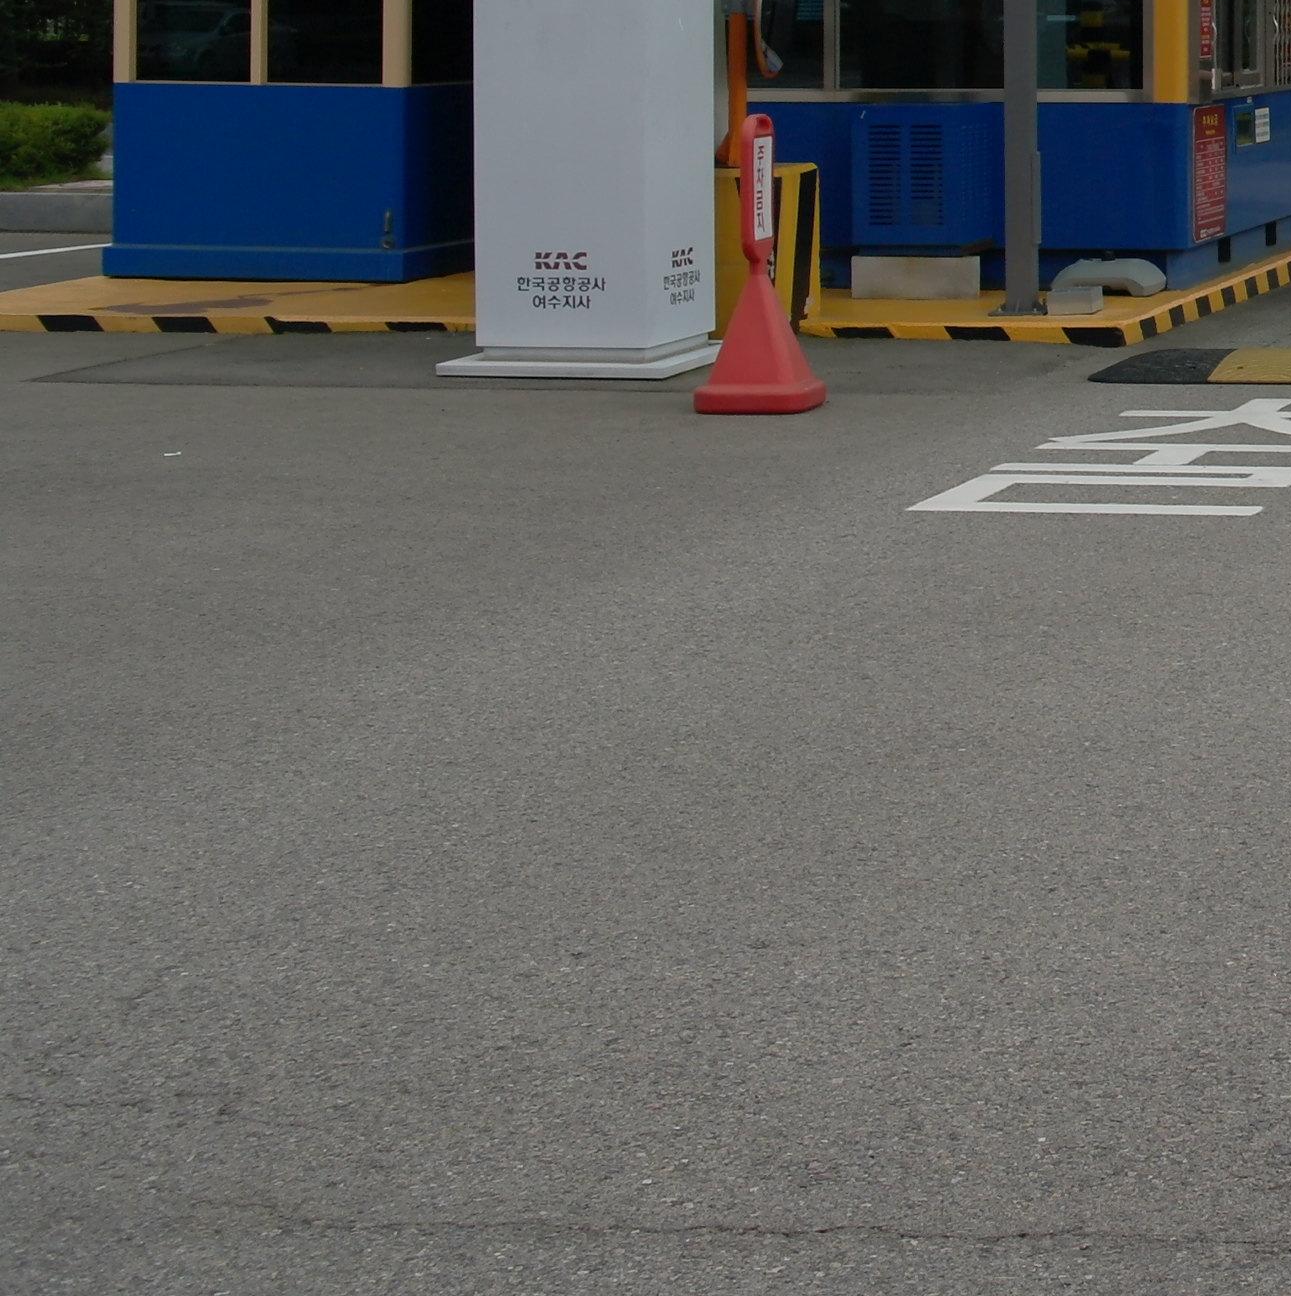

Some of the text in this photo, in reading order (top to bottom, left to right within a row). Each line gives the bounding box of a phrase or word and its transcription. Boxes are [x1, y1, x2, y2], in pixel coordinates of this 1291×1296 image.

[534, 252, 587, 271] KAC
[672, 247, 693, 268] KAC
[517, 277, 606, 292] 한국공항공사
[532, 295, 591, 309] 여수지사
